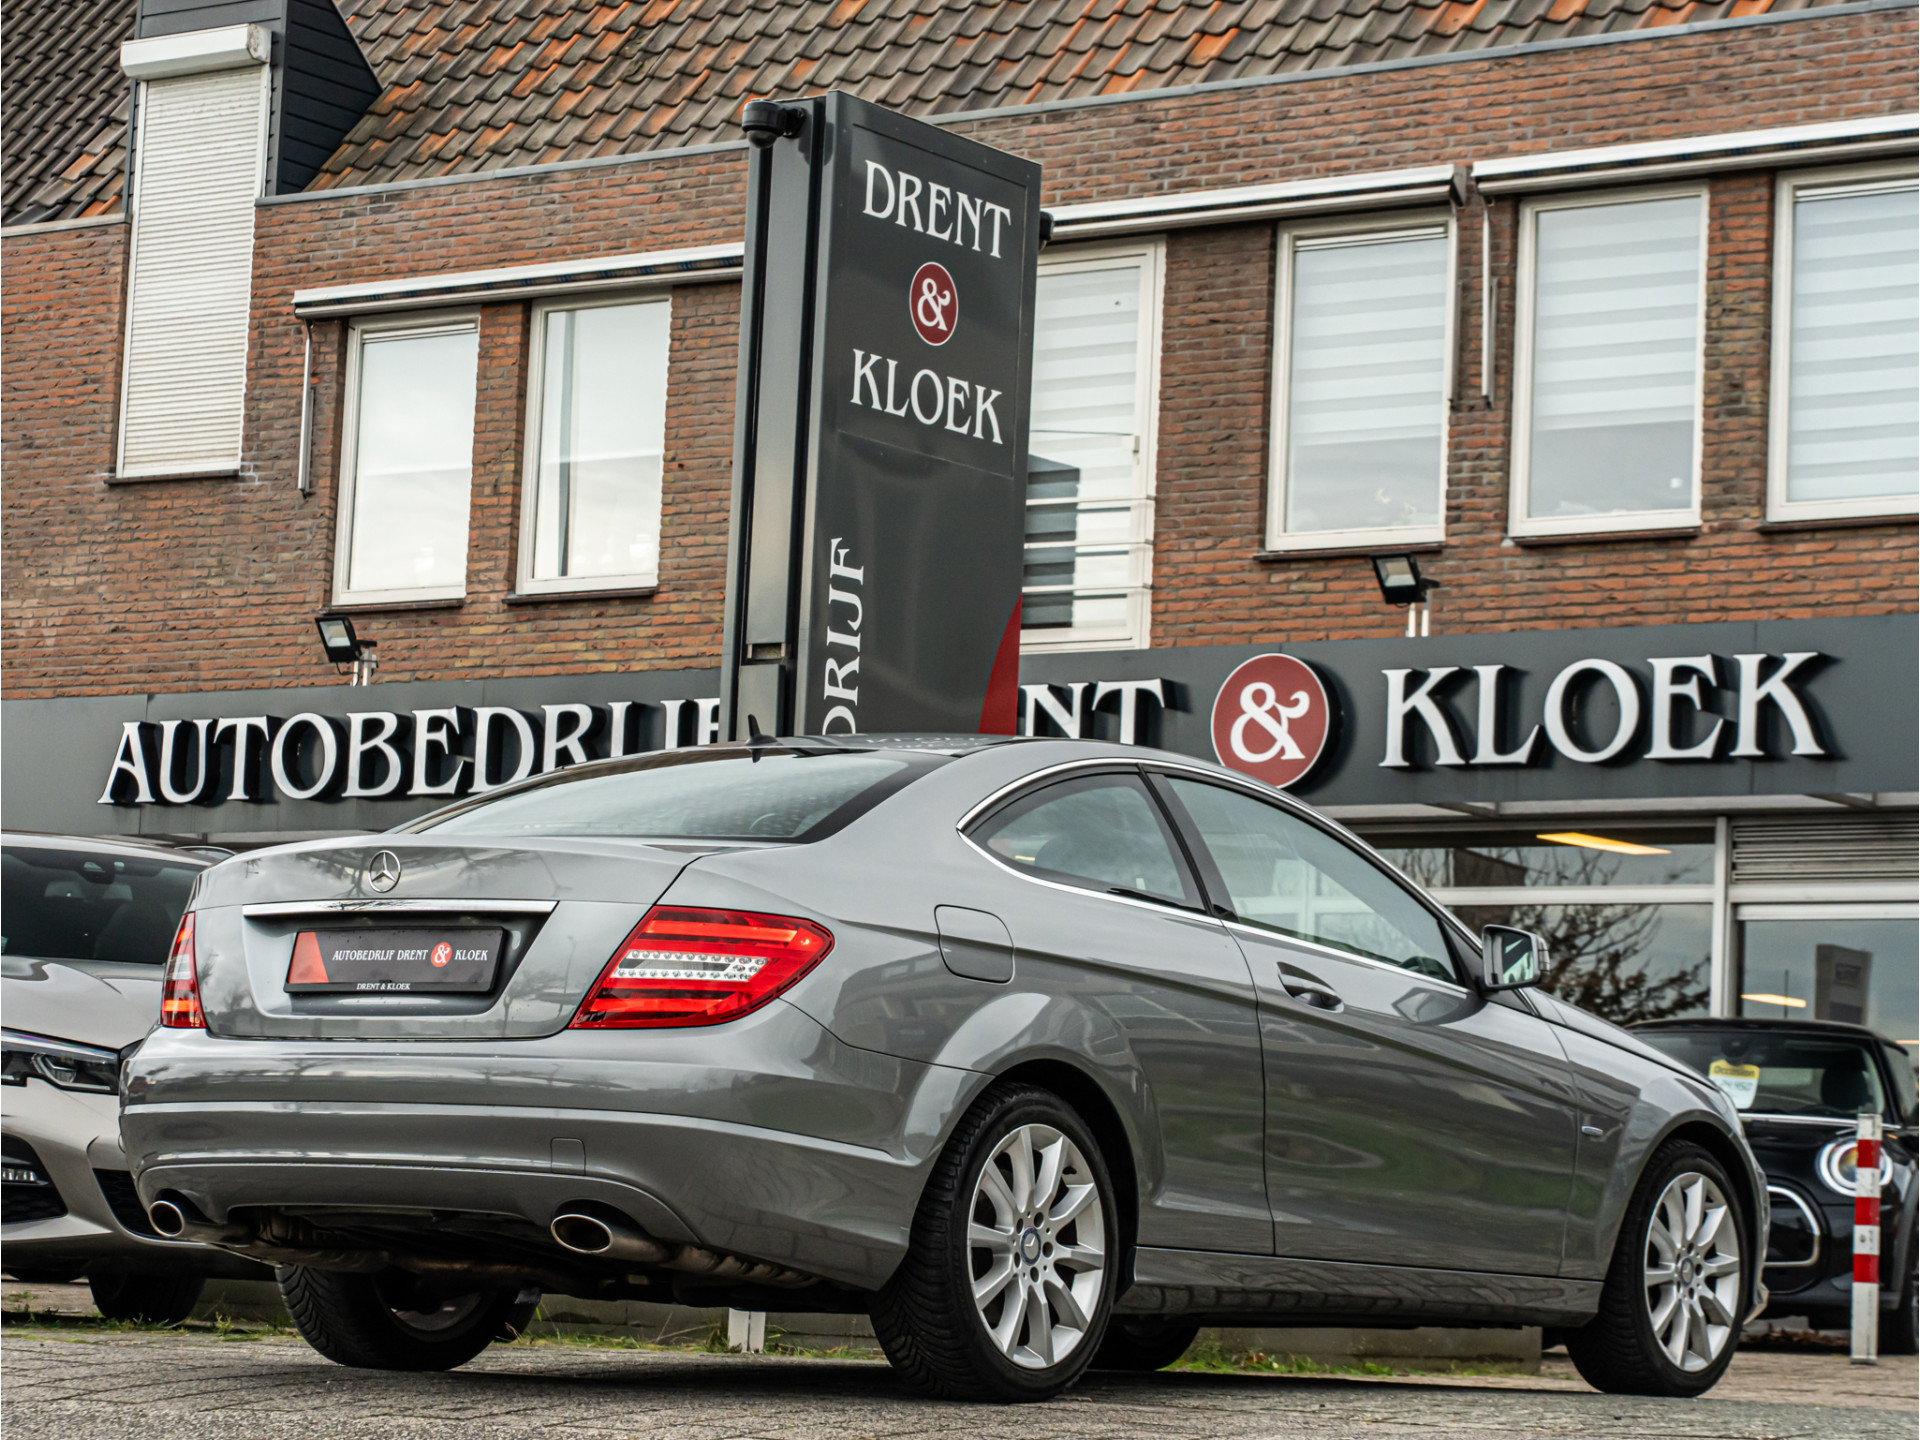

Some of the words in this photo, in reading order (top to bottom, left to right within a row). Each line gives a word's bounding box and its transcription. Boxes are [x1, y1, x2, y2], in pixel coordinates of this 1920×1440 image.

[862, 159, 1011, 259] DRENT
[917, 277, 951, 332] &
[850, 348, 1003, 445] KLOEK
[1230, 682, 1310, 763] &
[1379, 652, 1825, 767] KLOEK
[332, 949, 395, 961] AUTOBEDRIJF
[396, 949, 429, 961] DRENT
[434, 944, 450, 964] &
[454, 949, 489, 961] KLOEK
[356, 982, 380, 991] DRENT
[386, 982, 411, 991] KLOEK
